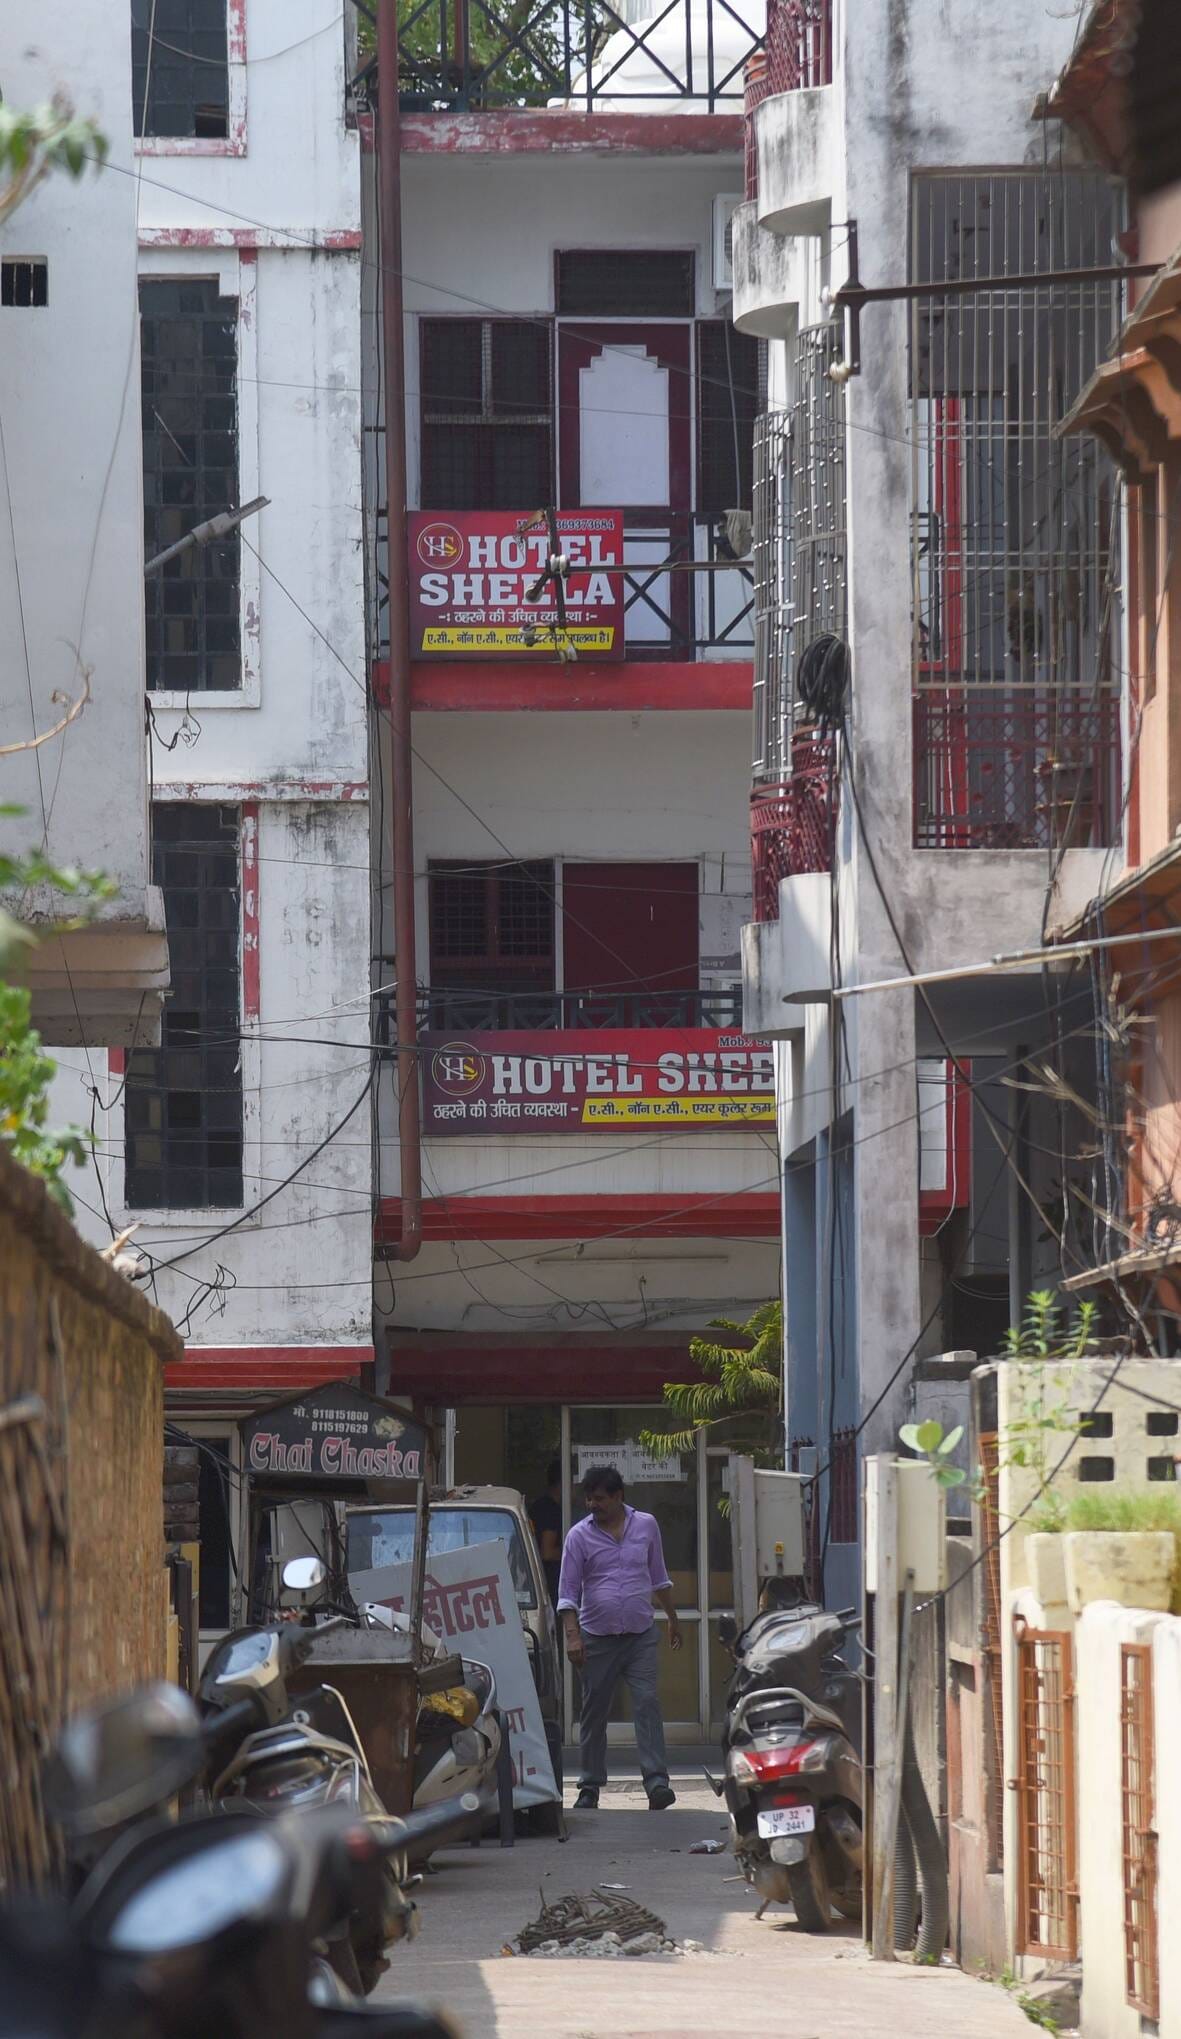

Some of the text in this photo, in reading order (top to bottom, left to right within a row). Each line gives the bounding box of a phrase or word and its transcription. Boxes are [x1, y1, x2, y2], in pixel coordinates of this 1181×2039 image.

[468, 535, 616, 569] HOTEL
[419, 573, 616, 606] SHEELA
[489, 608, 505, 623] की
[491, 1054, 643, 1094] HOTEL
[433, 1100, 467, 1119] ठहरने
[469, 1098, 487, 1118] की
[490, 1098, 521, 1118] उचित
[524, 1102, 568, 1118] व्यवस्था
[627, 1101, 650, 1115] नॉन
[692, 1103, 715, 1114] एयर
[718, 1102, 747, 1118] कूलर
[250, 1432, 420, 1479] Chai Chaska
[773, 1810, 799, 1822] UP 32
